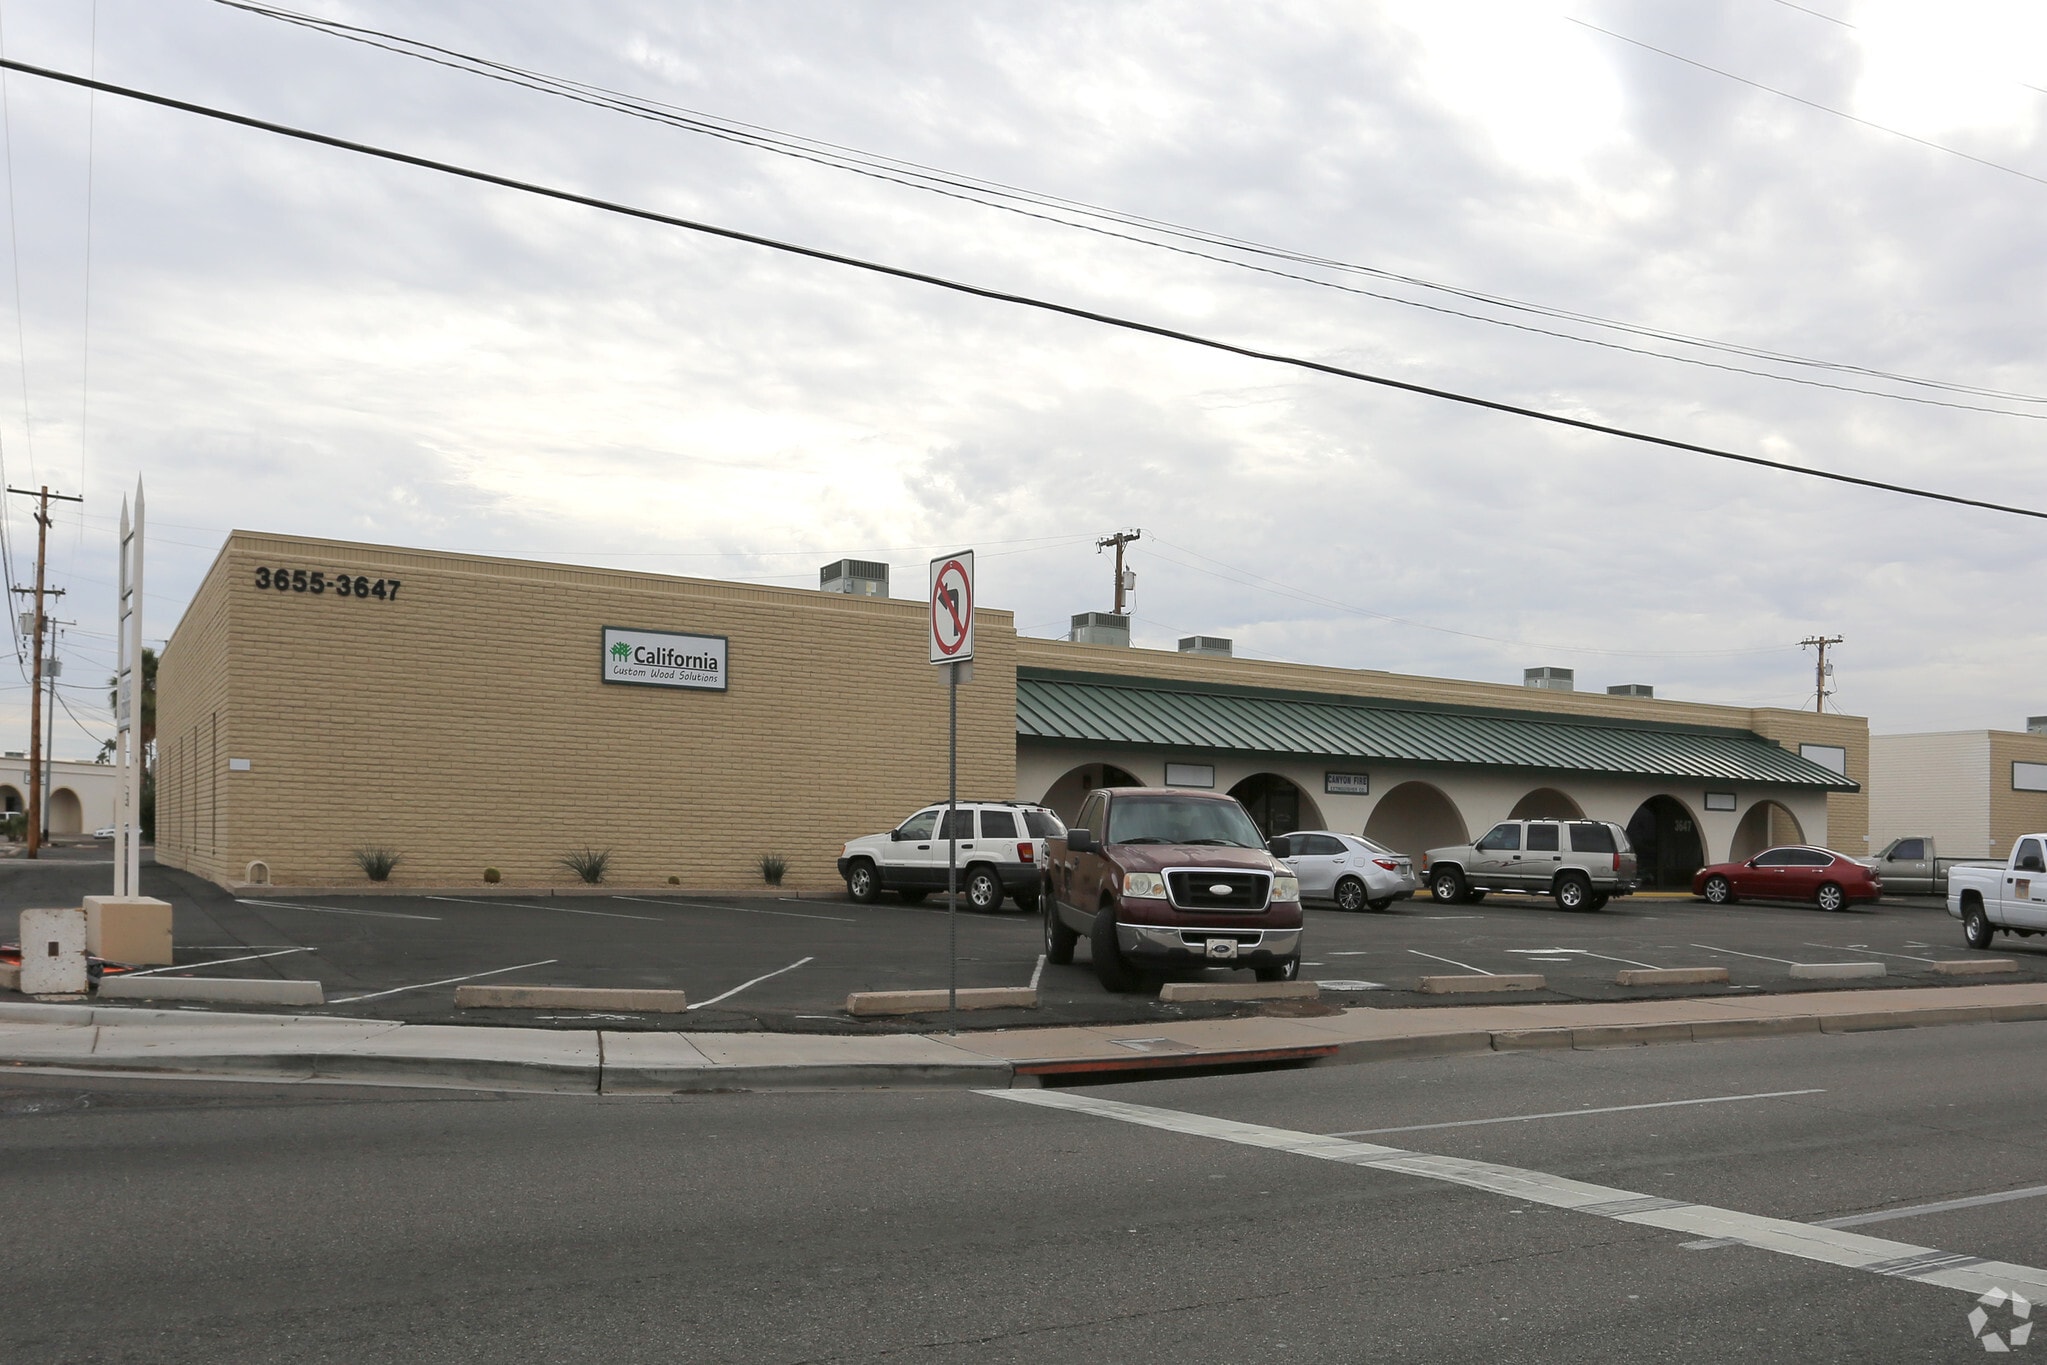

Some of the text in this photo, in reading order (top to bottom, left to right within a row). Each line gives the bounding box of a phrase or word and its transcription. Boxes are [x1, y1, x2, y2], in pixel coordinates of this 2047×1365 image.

[255, 566, 401, 601] 3655-3647
[634, 646, 718, 670] California
[613, 665, 718, 683] Custom Wood Solutions
[1328, 775, 1367, 786] CANYON FIRE
